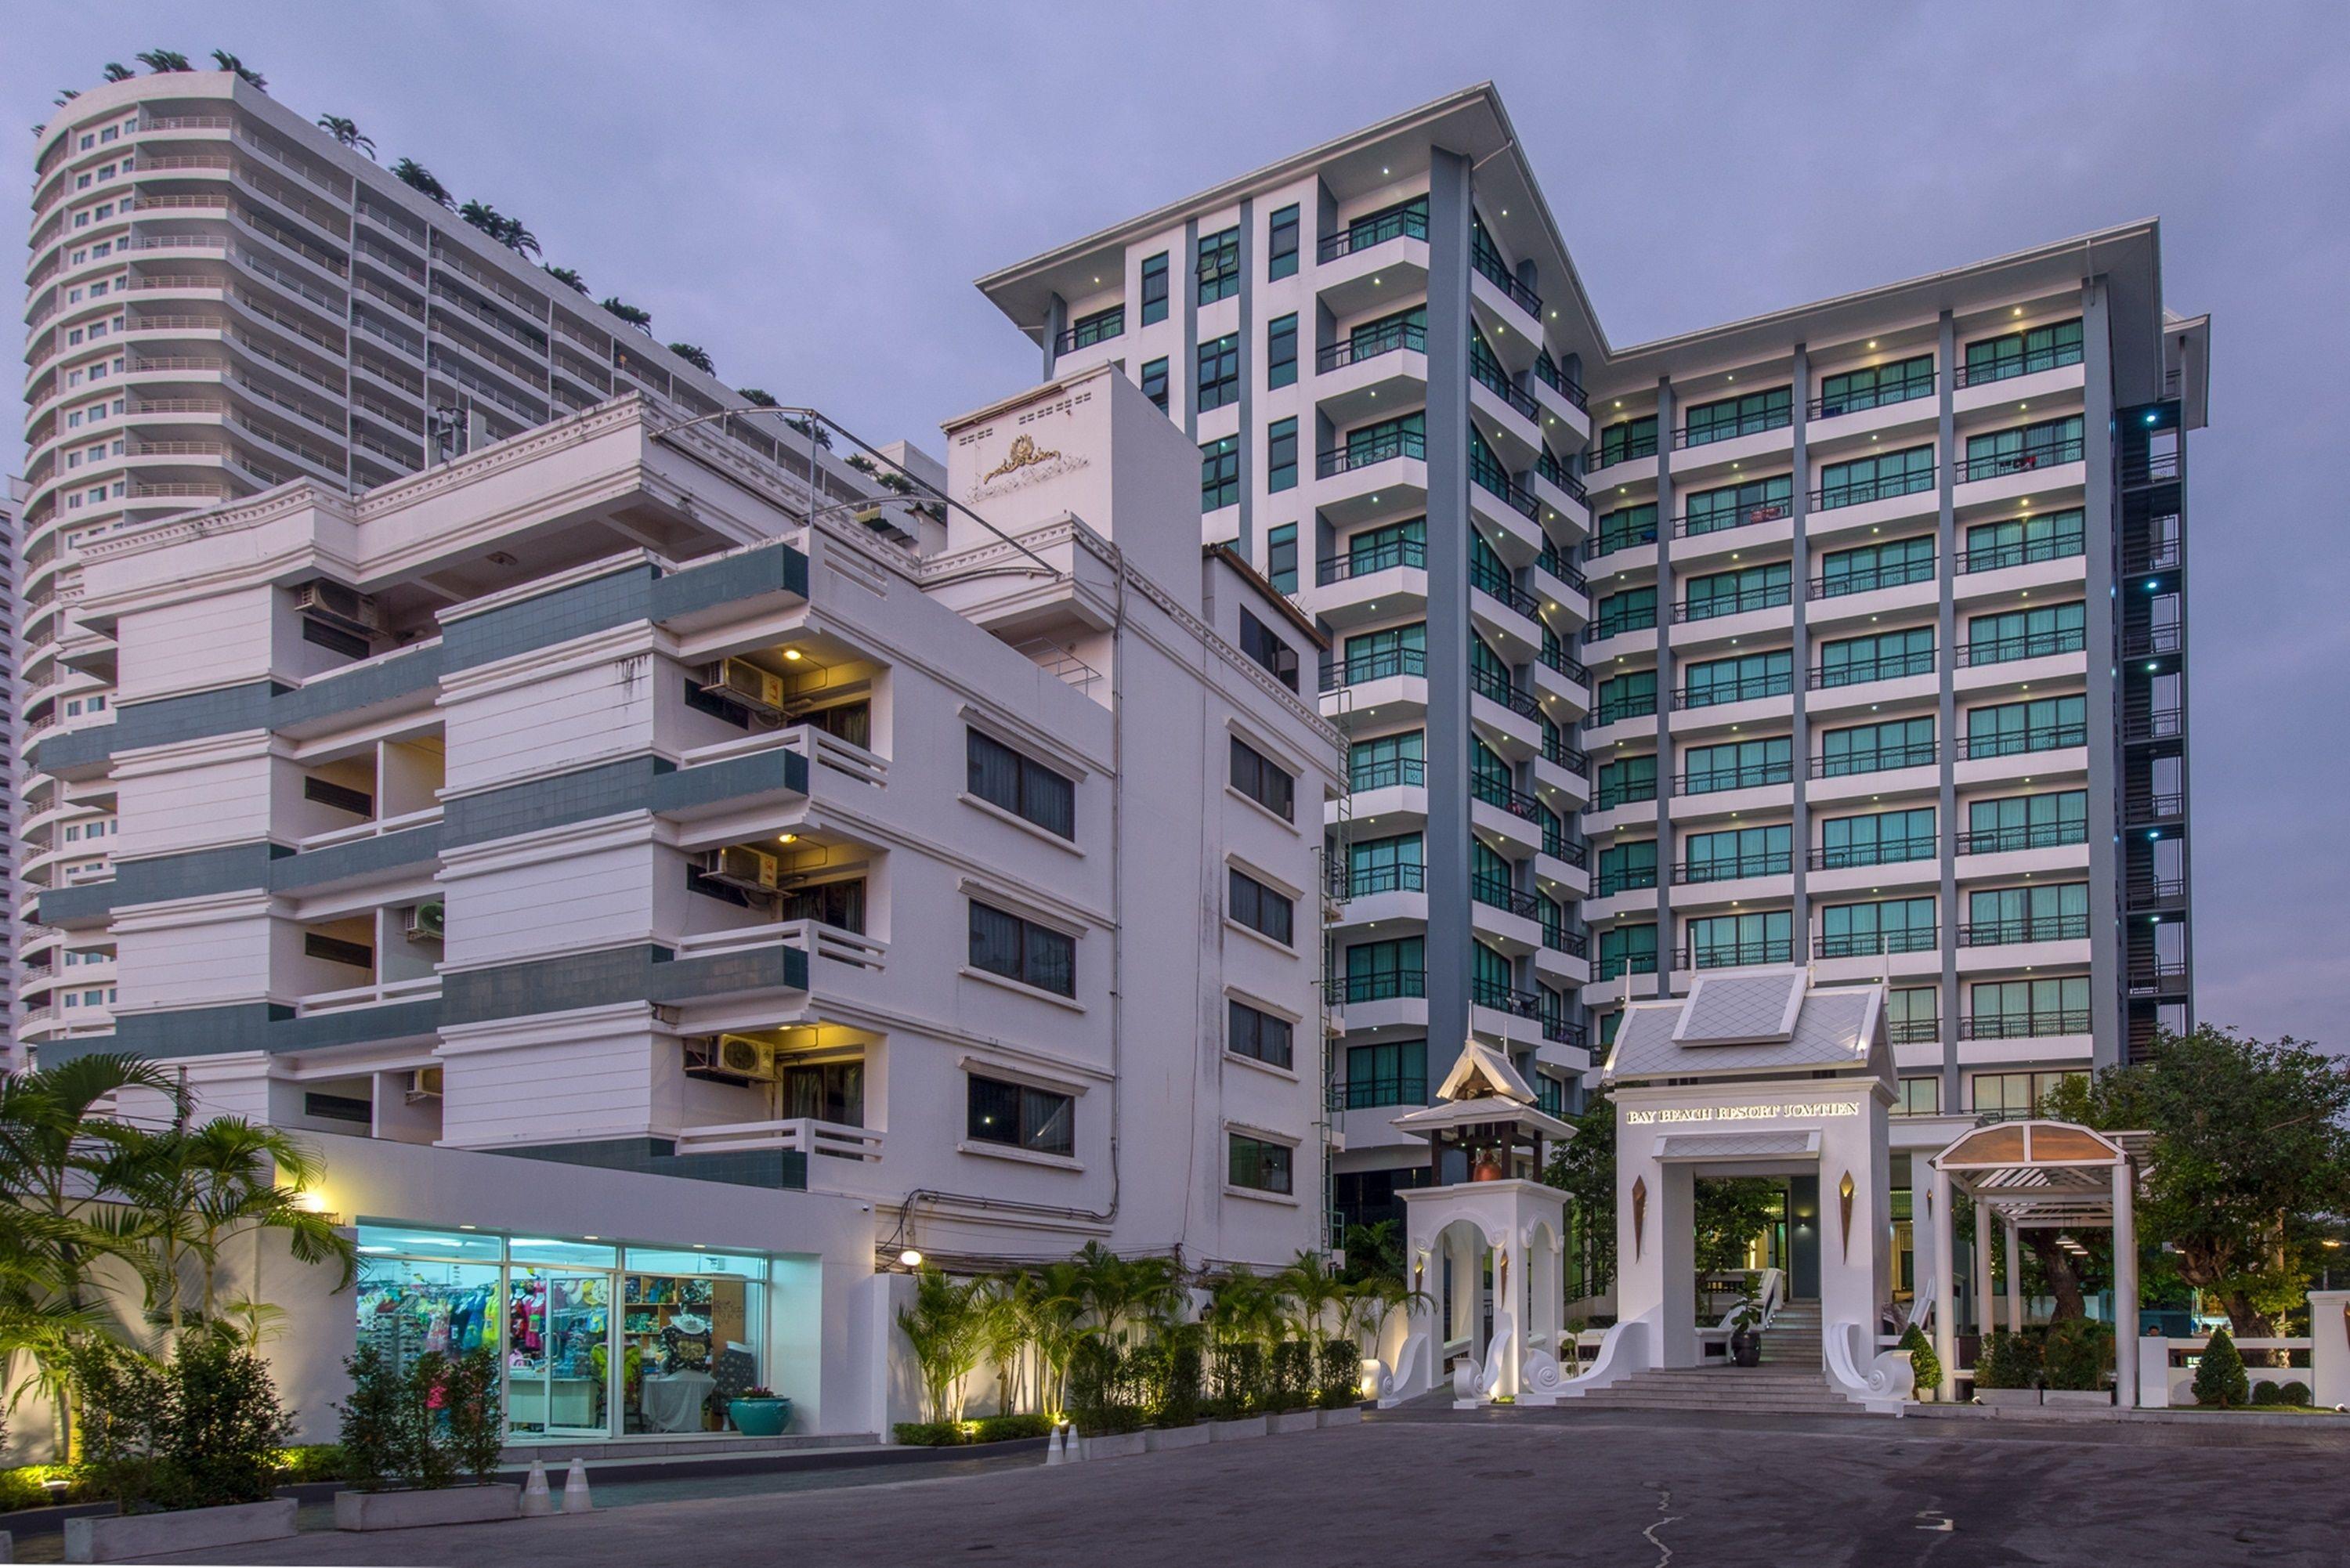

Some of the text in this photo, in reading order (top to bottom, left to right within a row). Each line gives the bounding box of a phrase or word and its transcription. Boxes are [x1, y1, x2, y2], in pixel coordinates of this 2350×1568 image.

[1627, 1102, 1860, 1124] BAY BEACH RESORT JOMTIEN
